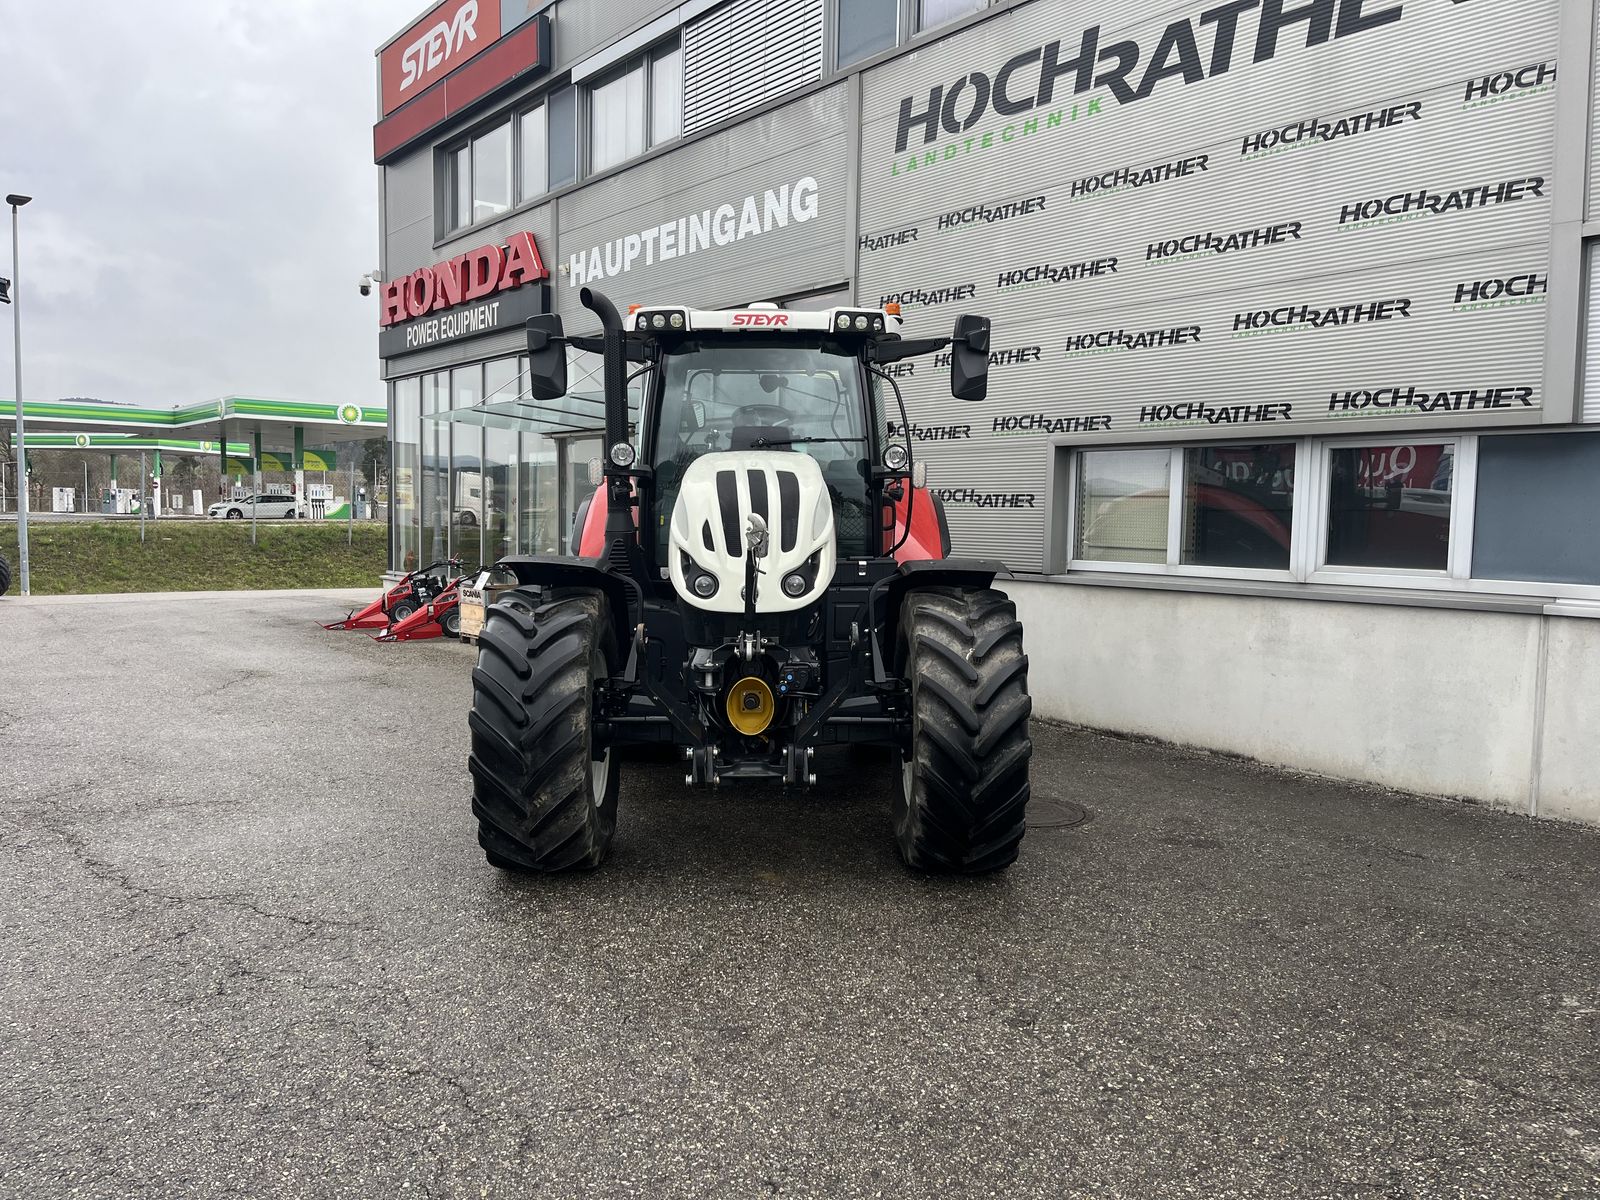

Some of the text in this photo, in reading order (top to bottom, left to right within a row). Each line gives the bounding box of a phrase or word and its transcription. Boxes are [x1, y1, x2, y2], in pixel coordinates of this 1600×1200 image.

[400, 0, 478, 92] STEYR
[895, 0, 1470, 154] HOCHRATH
[891, 96, 1104, 177] LANDTECHNIK
[1241, 101, 1422, 154] HOCHRATHER
[1070, 155, 1209, 198] HOCHRATHER
[938, 195, 1046, 230] HOCHRATHER
[1338, 176, 1545, 224] HOCHRATHER
[570, 176, 818, 287] HAUPTEINGANG
[1146, 221, 1302, 261] HOCHRATHER
[380, 231, 549, 327] HONDA
[997, 257, 1118, 288] HOCHRATHER
[880, 283, 976, 309] HOCHRATHER
[1232, 298, 1411, 331] HOCHRATHER
[406, 302, 499, 348] POWER EQUIPMENT
[732, 314, 789, 326] STEYR
[1066, 326, 1201, 351] HOCHRATHER
[1140, 402, 1292, 424] HOCHRATHER
[1328, 387, 1533, 412] HOCHRATHER
[992, 414, 1113, 433] HOCHRATHER
[462, 589, 482, 599] SCANIA
